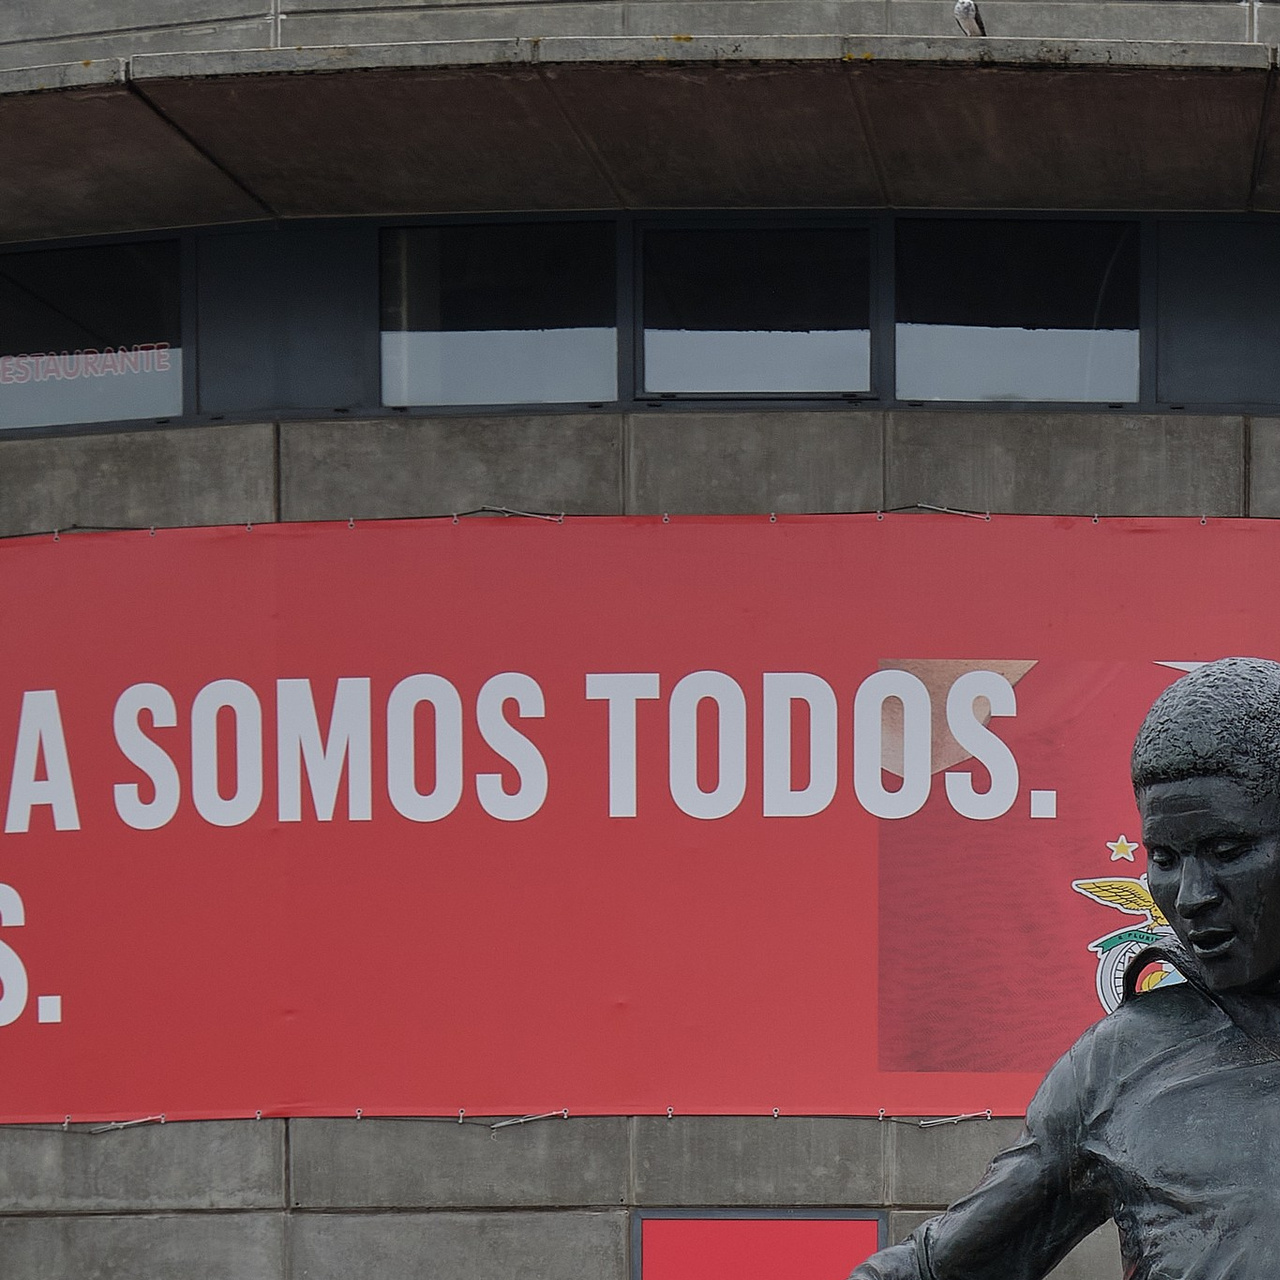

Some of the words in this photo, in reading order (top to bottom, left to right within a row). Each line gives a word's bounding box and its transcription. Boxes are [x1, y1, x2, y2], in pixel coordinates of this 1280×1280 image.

[4, 689, 80, 833] A
[113, 671, 548, 830] SOMOS
[585, 668, 1057, 821] TODOS.
